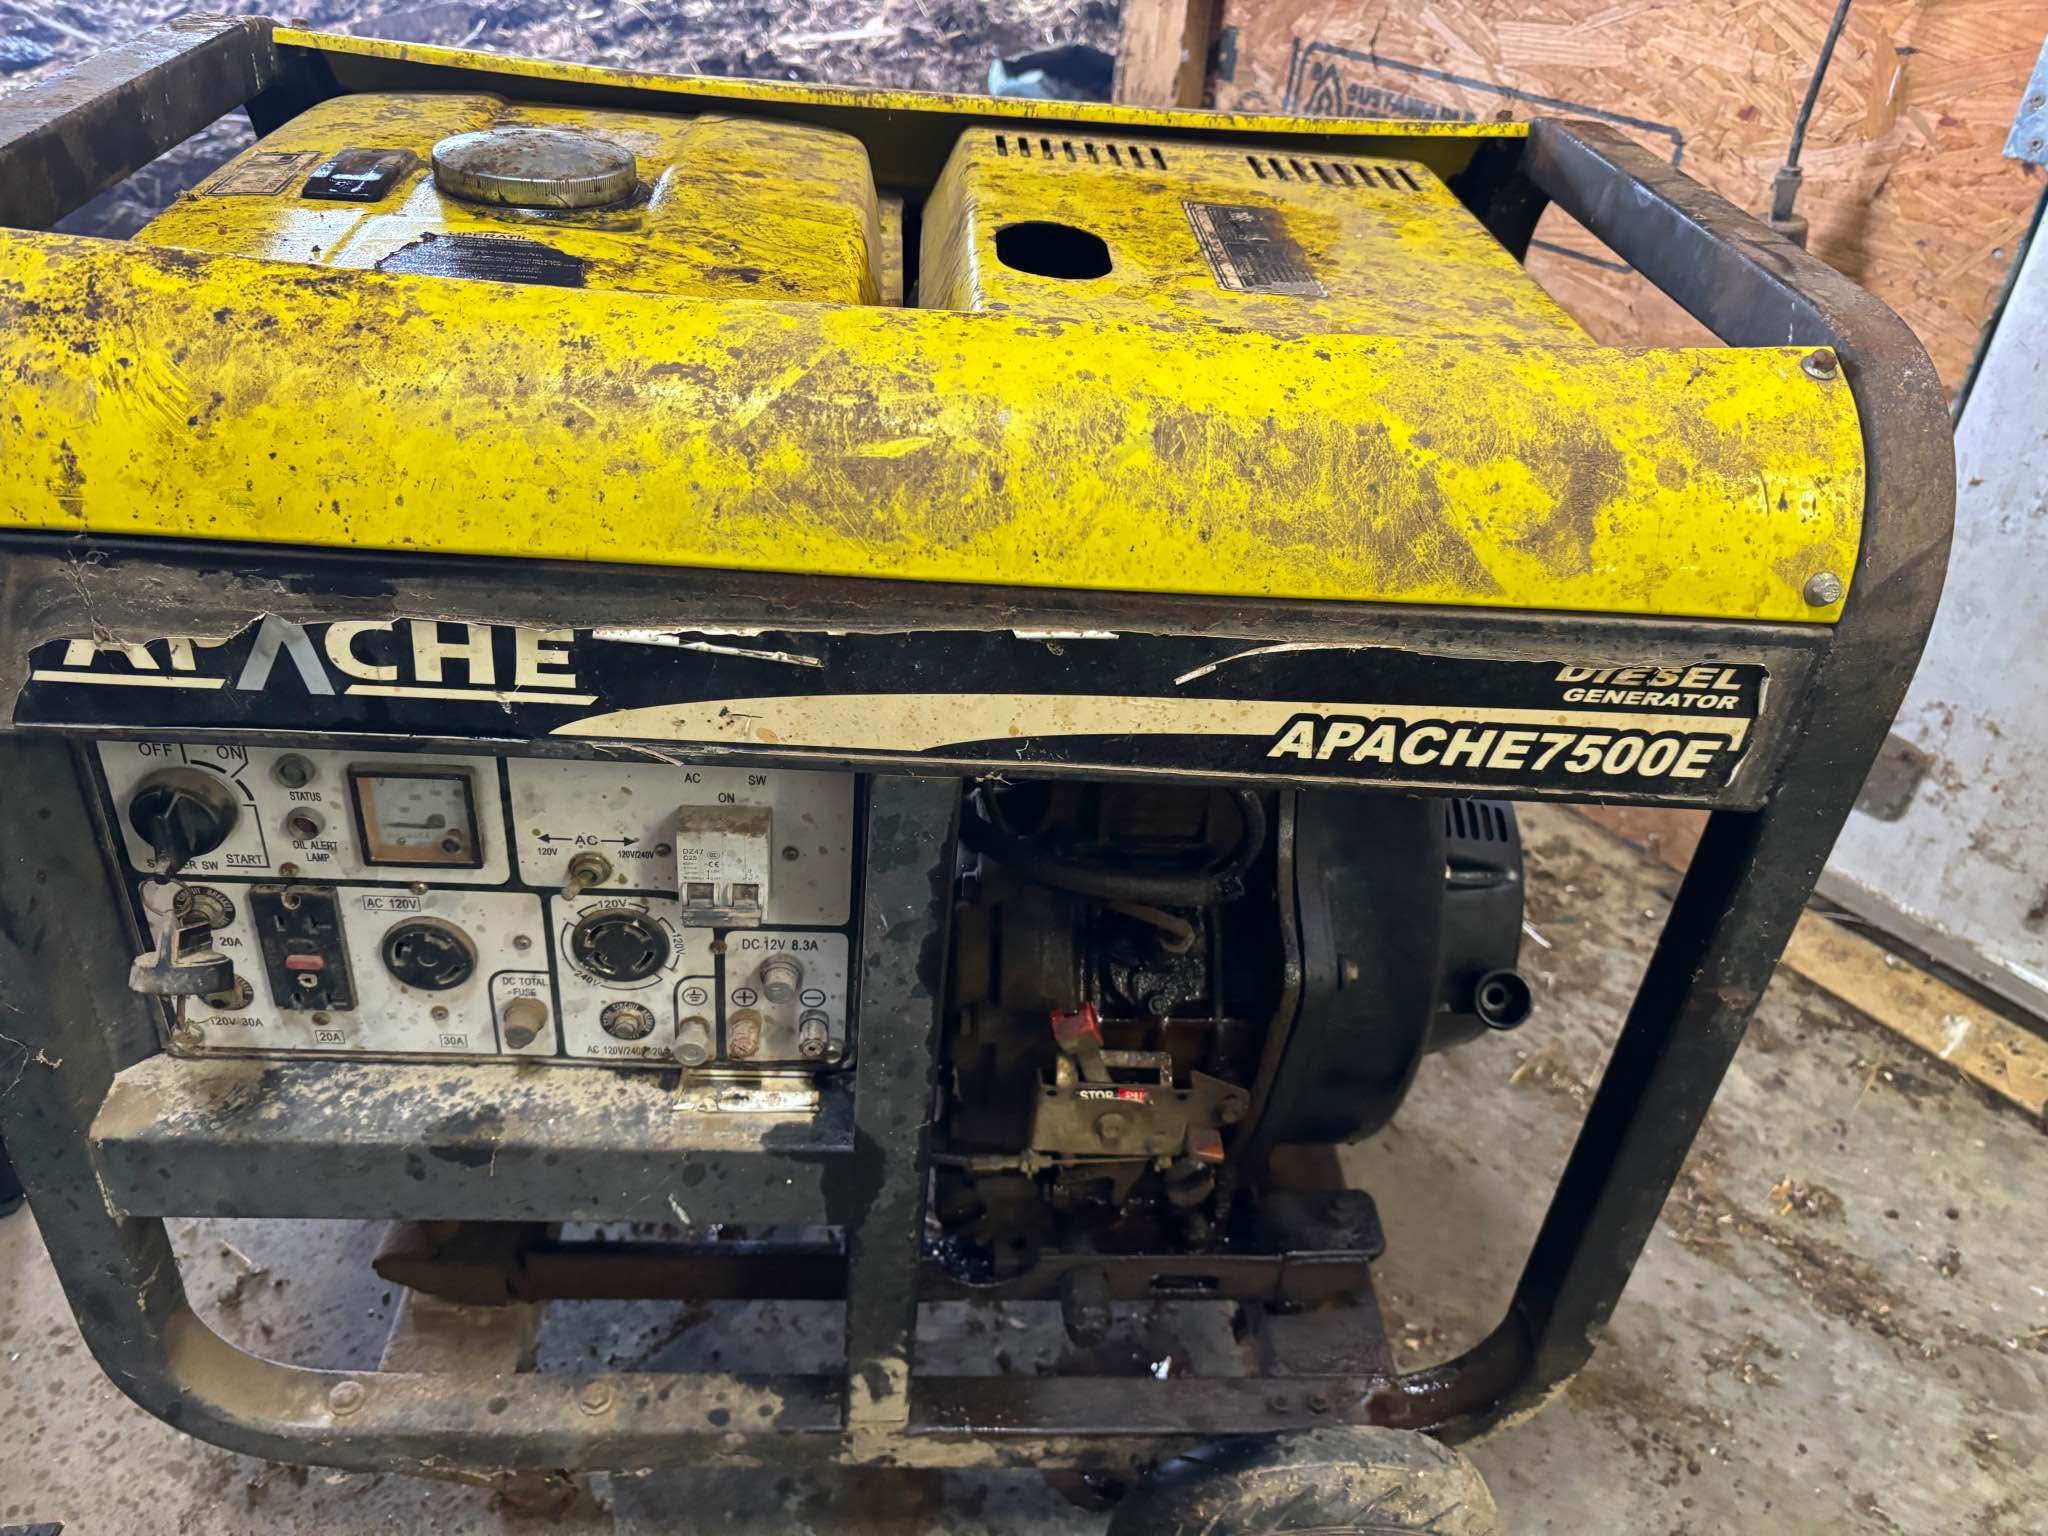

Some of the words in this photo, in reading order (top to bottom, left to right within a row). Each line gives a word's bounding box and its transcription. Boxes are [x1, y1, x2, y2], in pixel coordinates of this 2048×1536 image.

[1555, 666, 1742, 691] DIESEL
[1562, 687, 1740, 710] GENERATOR
[138, 742, 173, 757] OFF
[216, 745, 244, 761] ON
[1266, 720, 1723, 778] APACHE7500E
[684, 772, 702, 784] AC
[748, 775, 767, 786] SW
[289, 790, 322, 802] STATUS
[717, 792, 735, 804] ON
[292, 839, 308, 850] OIL
[310, 840, 338, 851] ALERT
[574, 834, 599, 847] AC
[537, 846, 558, 856] 120V
[617, 849, 655, 861] 120V/240V
[225, 853, 263, 866] START
[305, 852, 331, 863] LAMP
[201, 860, 219, 871] SW
[366, 897, 384, 909] AC
[389, 898, 417, 910] 120V
[599, 898, 627, 909] 120V
[219, 936, 243, 947] 20A
[671, 933, 687, 956] 120V
[742, 938, 760, 950] DC
[764, 937, 786, 950] 12V
[791, 940, 819, 951] 8.3A
[502, 976, 516, 986] DC
[519, 976, 548, 987] TOTAL
[574, 970, 600, 986] 240V
[512, 987, 537, 997] FUSE
[319, 1032, 341, 1042] 20A
[443, 1035, 465, 1046] 30A
